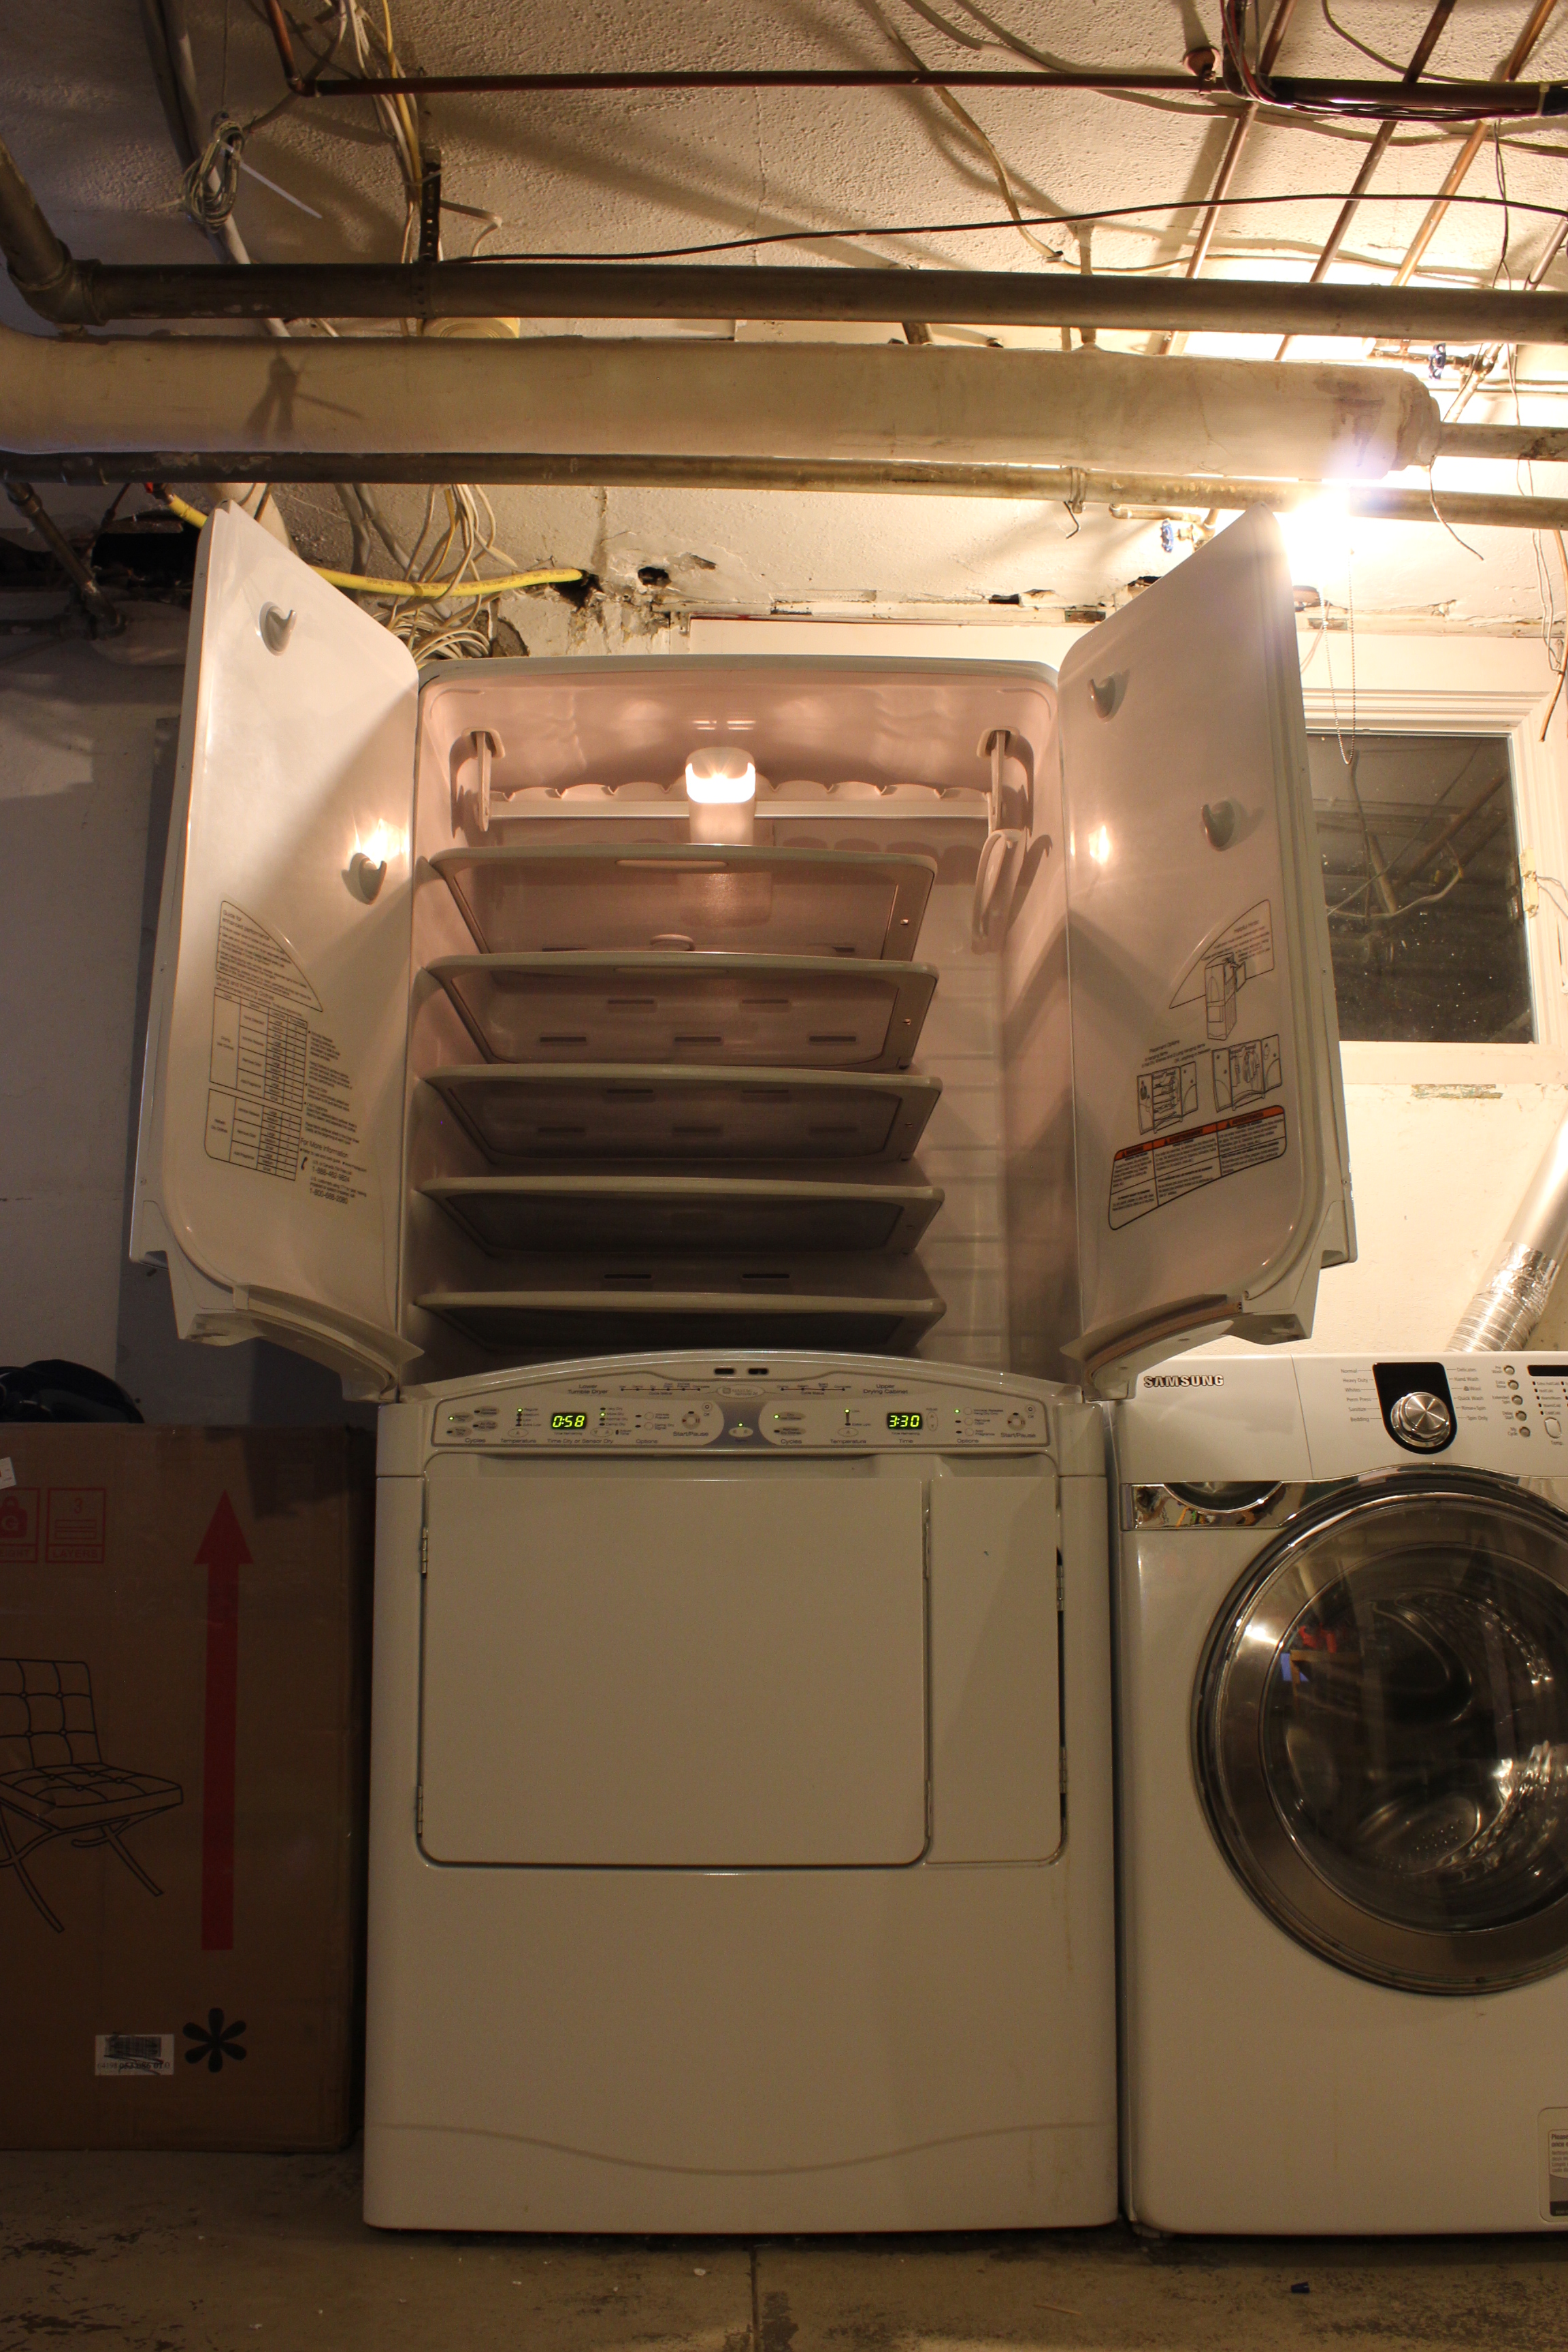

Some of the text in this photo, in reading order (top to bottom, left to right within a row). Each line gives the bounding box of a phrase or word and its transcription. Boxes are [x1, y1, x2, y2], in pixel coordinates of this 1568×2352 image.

[1143, 1375, 1224, 1388] SAMSUNG
[552, 1415, 585, 1428] 0:58
[889, 1415, 920, 1428] 3:30
[74, 1497, 82, 1514] 3
[52, 1549, 98, 1558] LAYERS
